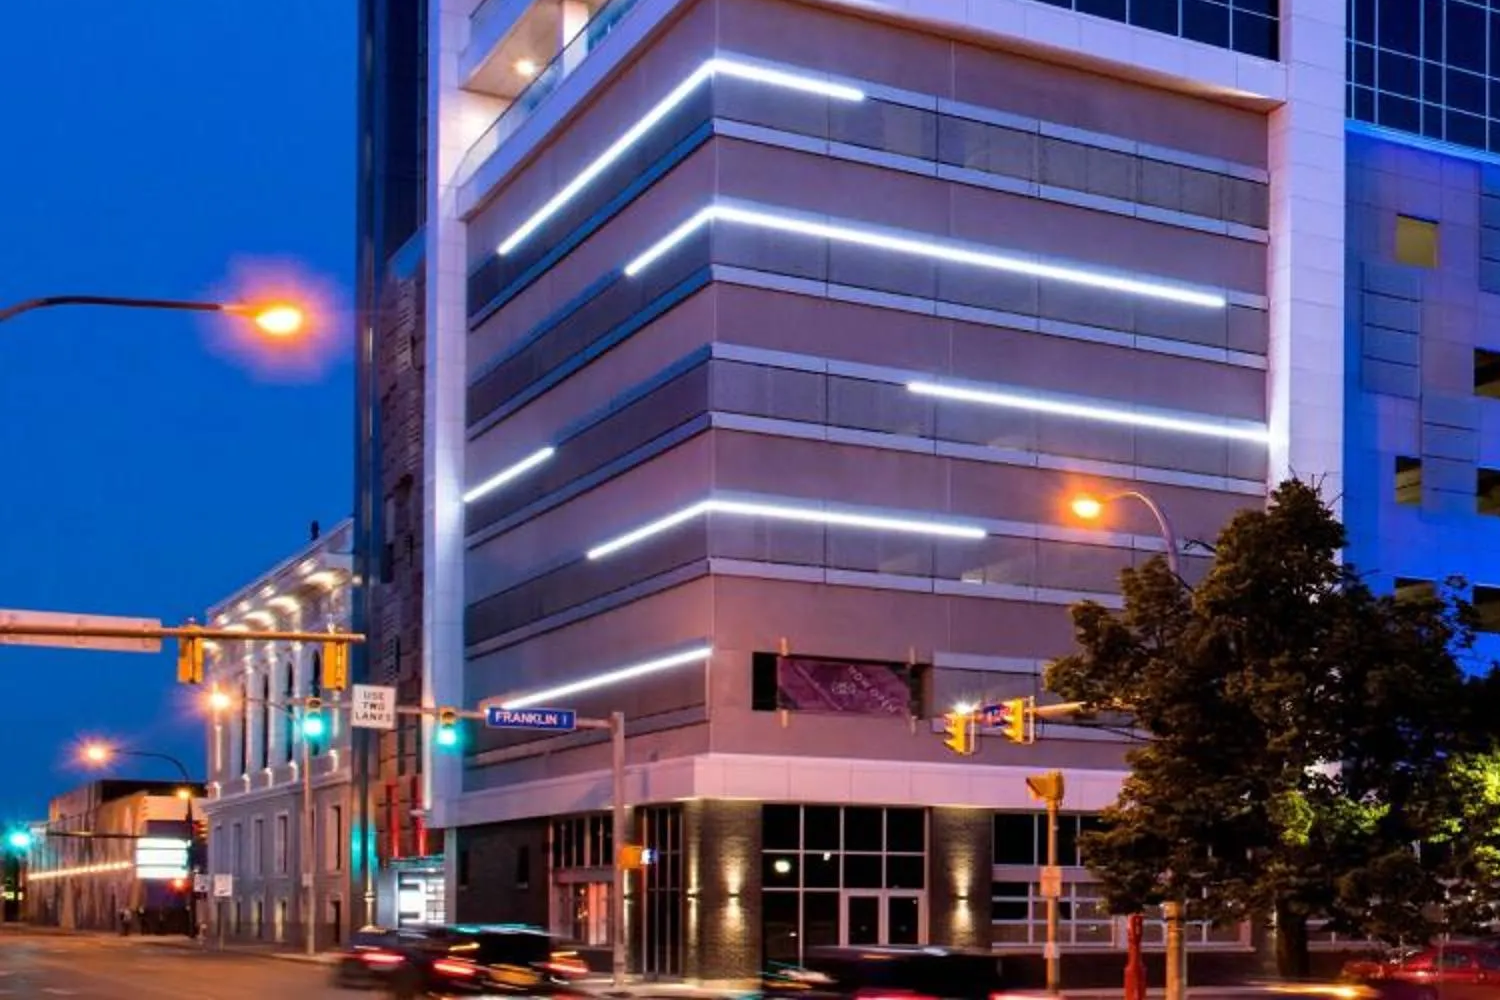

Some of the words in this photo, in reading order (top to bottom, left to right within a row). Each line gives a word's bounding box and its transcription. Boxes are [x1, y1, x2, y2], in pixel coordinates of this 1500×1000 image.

[363, 691, 385, 701] USE
[361, 701, 385, 711] TWO
[355, 711, 391, 722] LANES
[495, 710, 558, 726] FRANKLIN
